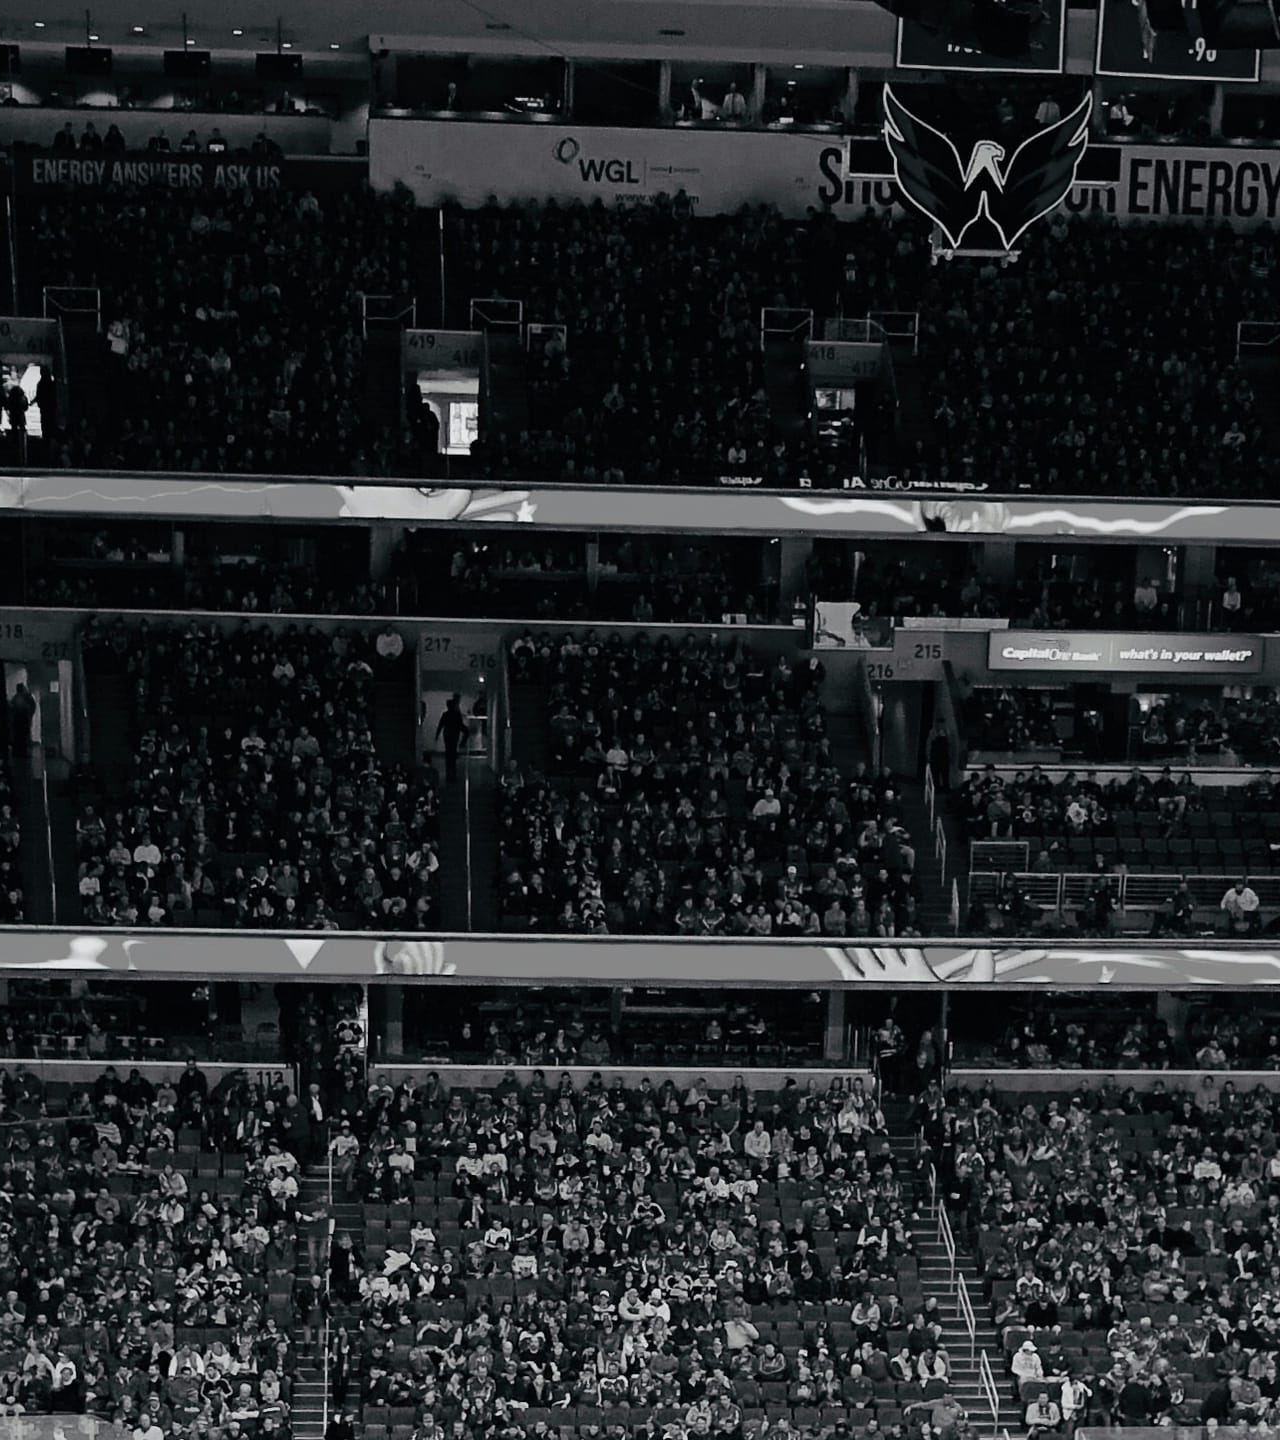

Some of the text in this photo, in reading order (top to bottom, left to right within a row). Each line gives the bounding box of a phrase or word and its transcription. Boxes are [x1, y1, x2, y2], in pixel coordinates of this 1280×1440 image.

[31, 158, 107, 185] ENERGY
[213, 164, 252, 191] ASK
[255, 165, 282, 191] US
[578, 159, 640, 184] WGL
[409, 334, 435, 349] 419
[40, 642, 68, 658] 217
[424, 637, 451, 653] 217
[913, 644, 941, 660] 215
[469, 653, 497, 669] 216
[1119, 647, 1159, 661] what's
[1160, 648, 1173, 661] in
[1172, 650, 1203, 664] your
[866, 663, 894, 679] 216
